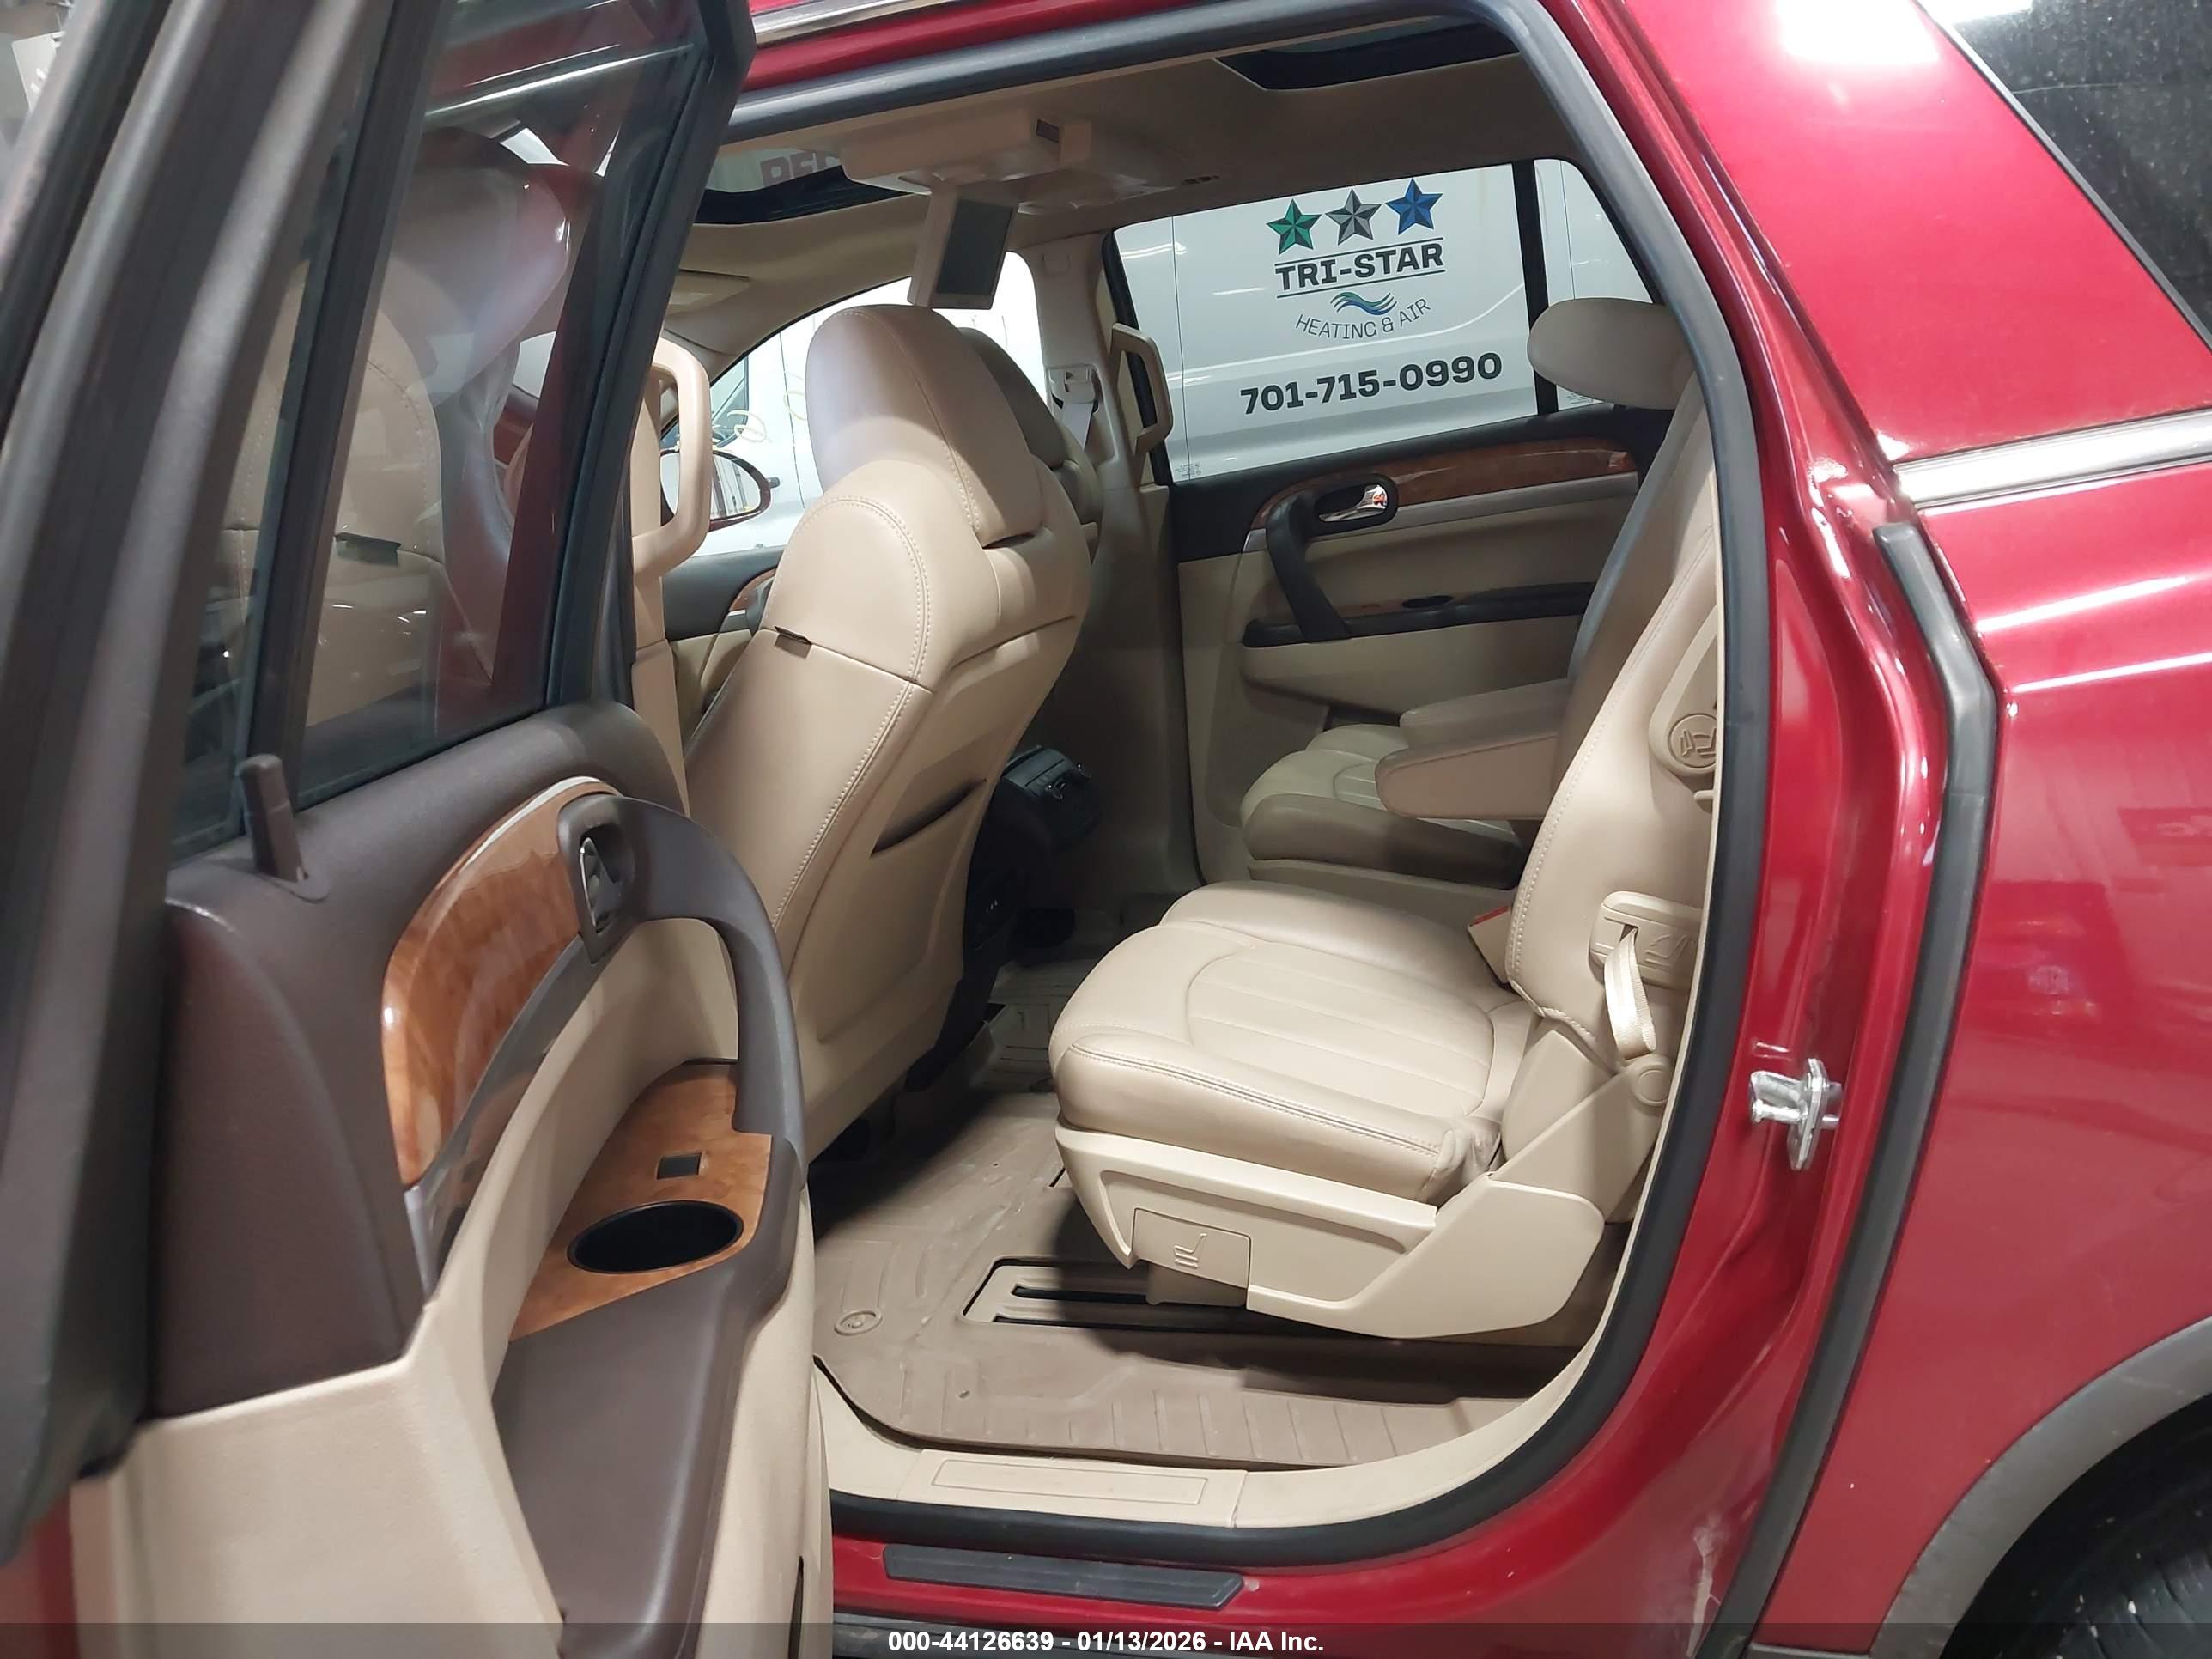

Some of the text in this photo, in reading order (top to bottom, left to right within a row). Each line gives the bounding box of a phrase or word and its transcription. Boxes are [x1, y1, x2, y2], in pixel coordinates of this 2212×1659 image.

[1275, 242, 1444, 291] TRI-STAR
[1295, 298, 1431, 339] HEATING & AIR
[1239, 352, 1503, 415] 701-715-0990
